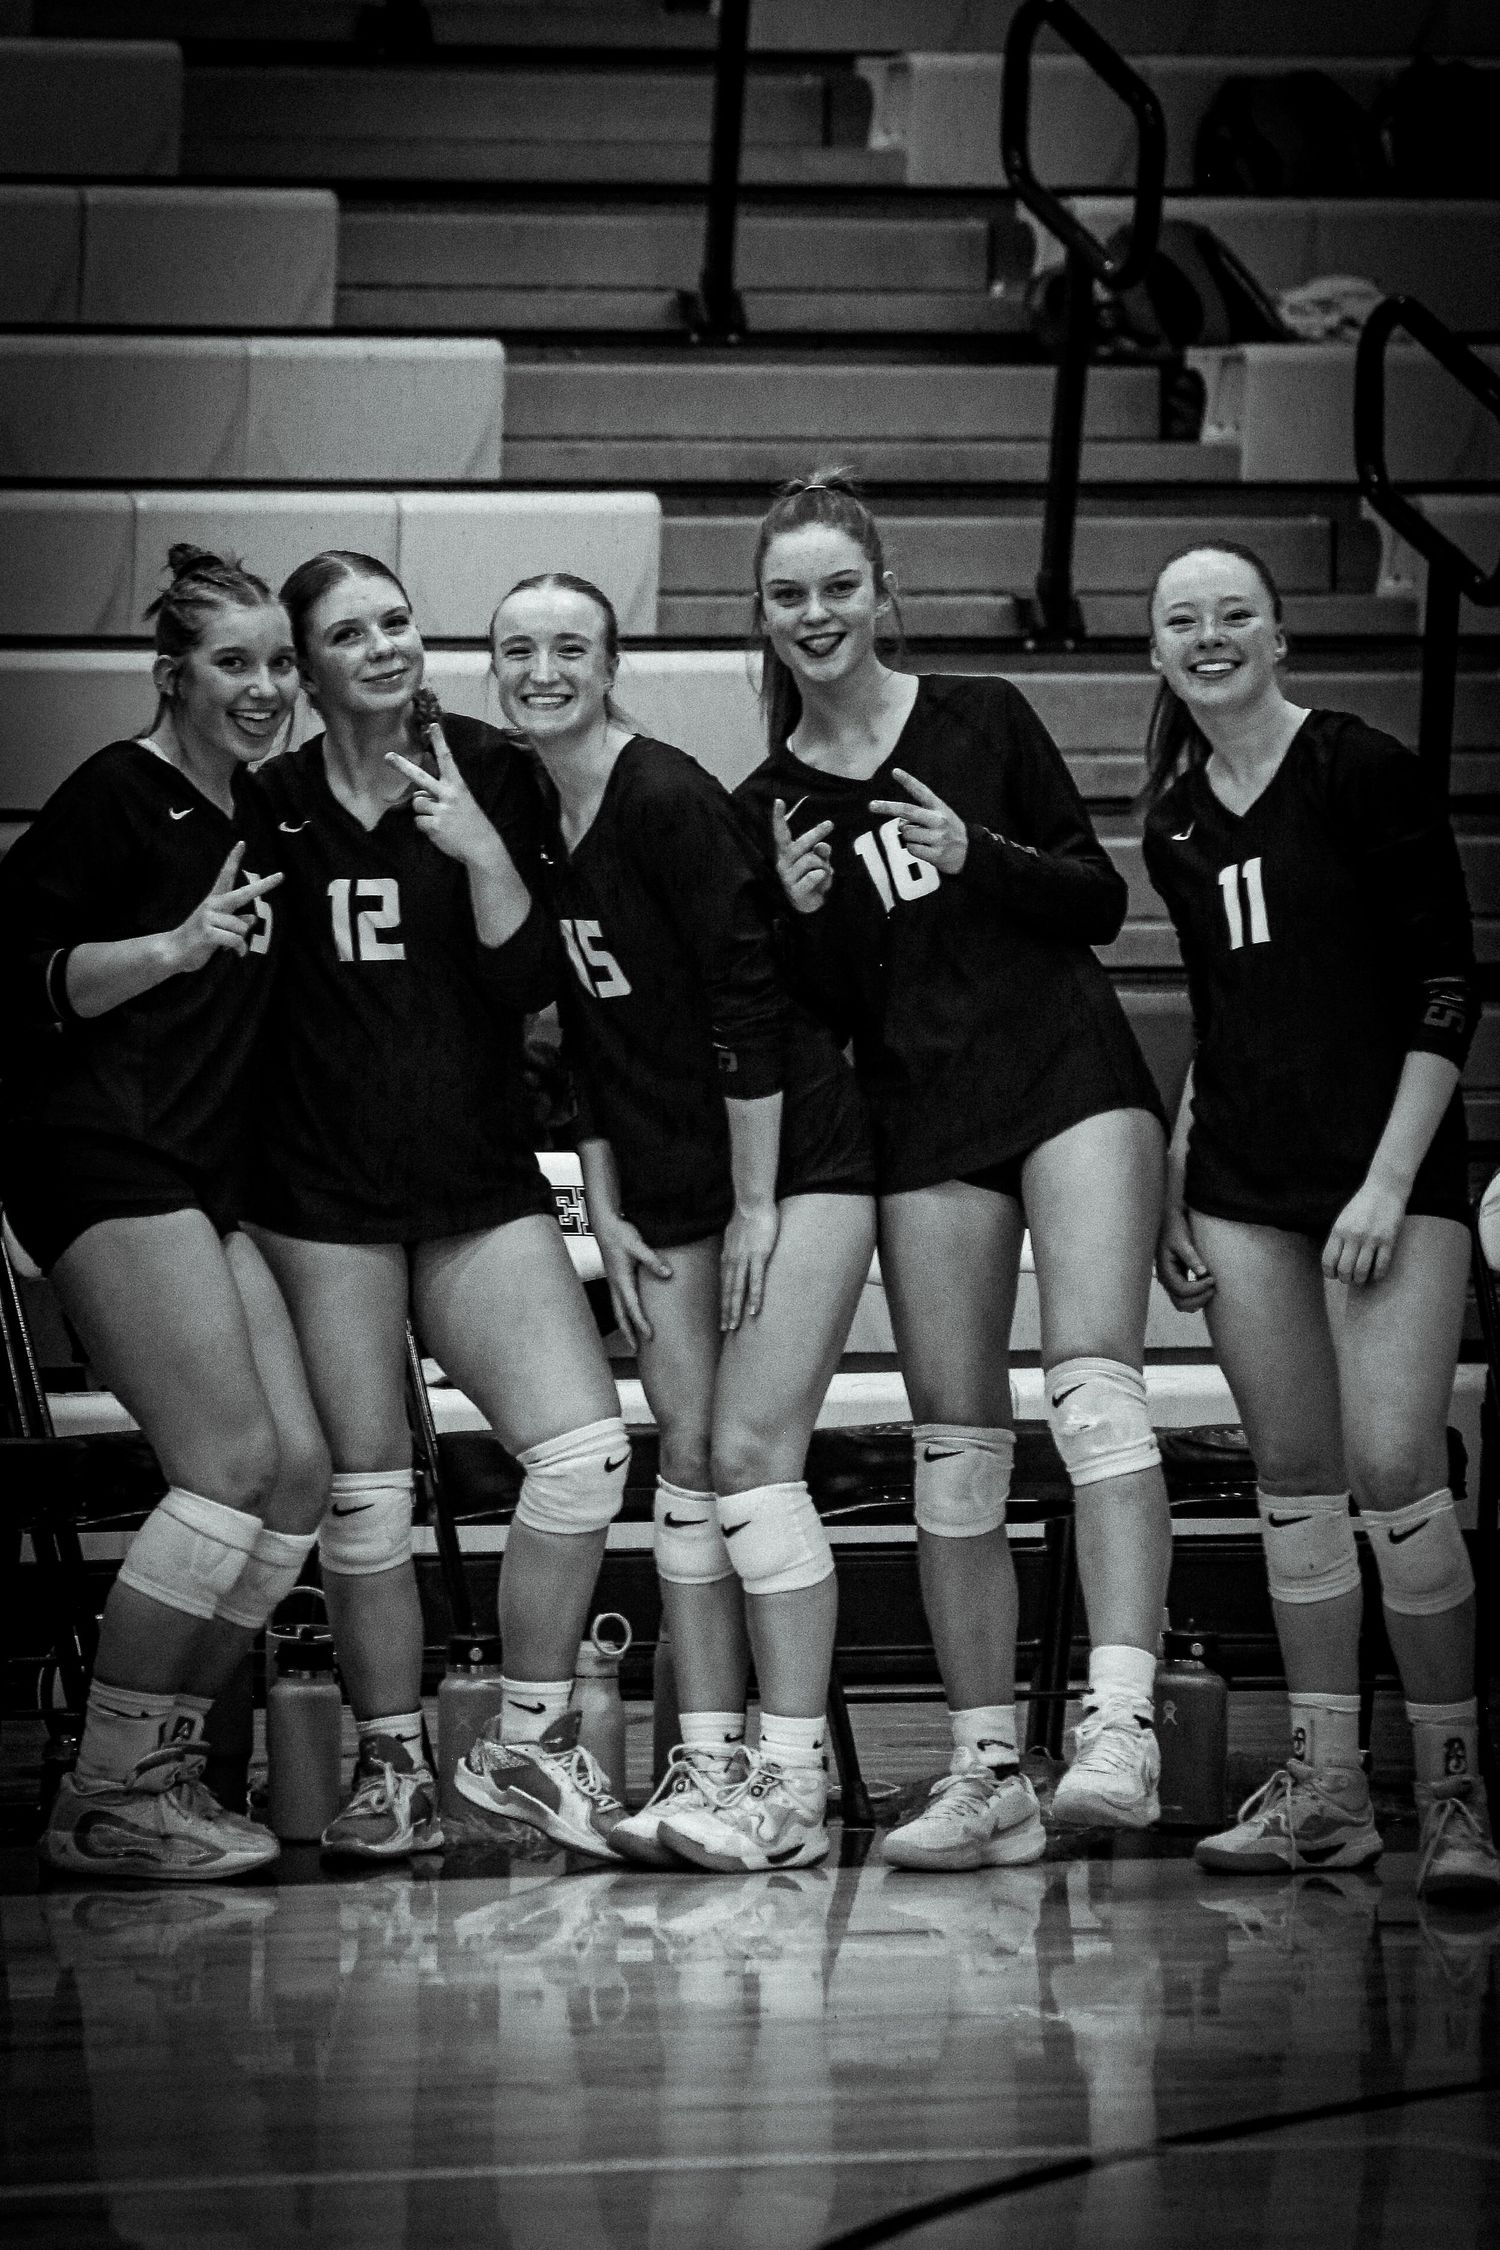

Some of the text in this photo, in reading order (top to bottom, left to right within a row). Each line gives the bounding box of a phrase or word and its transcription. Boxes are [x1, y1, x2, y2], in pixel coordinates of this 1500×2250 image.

[853, 816, 940, 913] 16
[1217, 856, 1270, 951] 11
[326, 877, 406, 962] 12
[559, 919, 632, 999] 15
